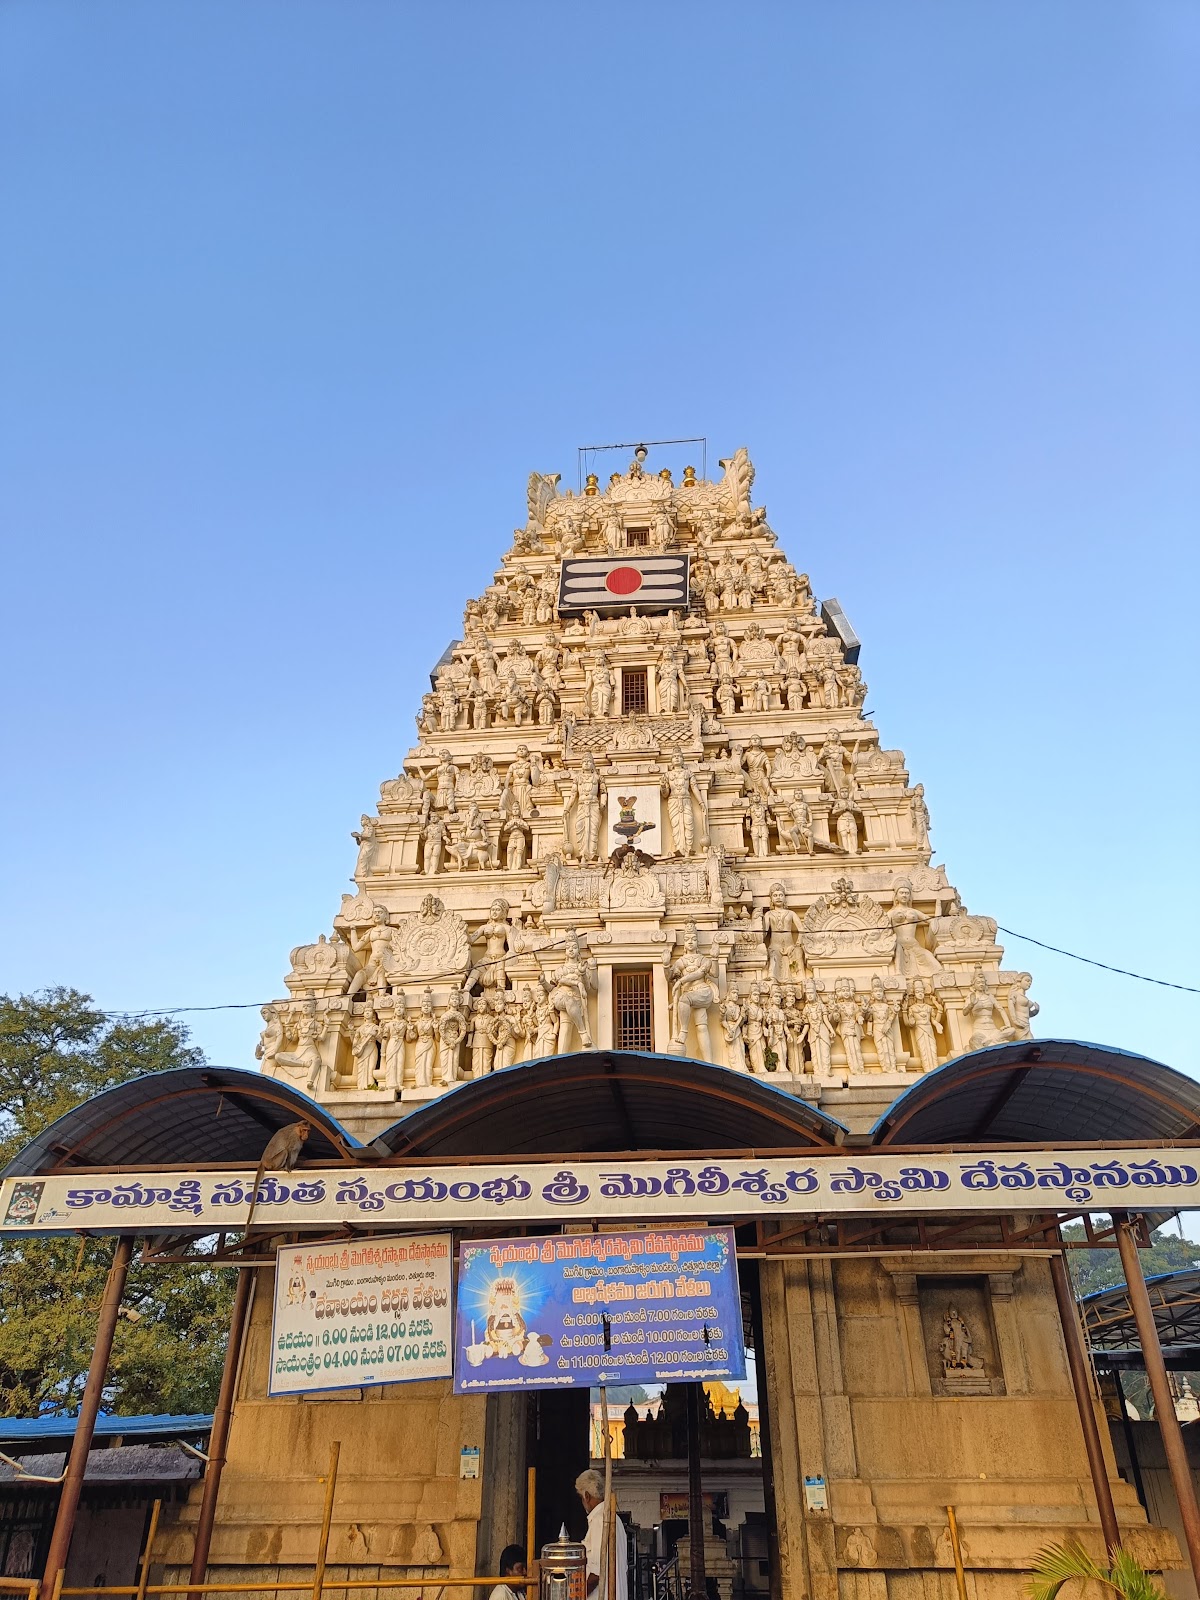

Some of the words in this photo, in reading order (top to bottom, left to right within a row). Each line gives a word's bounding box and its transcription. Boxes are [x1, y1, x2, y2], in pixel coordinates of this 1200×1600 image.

[66, 1180, 203, 1215] కామాక్షి
[210, 1177, 326, 1206] సమేత
[336, 1174, 532, 1211] స్వయంభు
[542, 1171, 590, 1204] శ్రీ
[597, 1166, 820, 1203] మొగిలీశ్వర
[829, 1164, 951, 1202] స్వామి
[306, 1252, 339, 1275] స్వయంభు
[340, 1250, 350, 1271] శ్రీ
[489, 1242, 539, 1267] స్వయంభు
[541, 1240, 555, 1263] శ్రీ
[314, 1291, 378, 1320] దేవాలయం
[380, 1286, 409, 1320] దర్శన
[412, 1282, 448, 1311] వేళలు
[572, 1279, 636, 1305] అభిషేకము
[636, 1279, 675, 1298] జరుగు
[675, 1275, 712, 1298] వేళలు
[576, 1313, 600, 1326] 6.00
[624, 1308, 648, 1324] నుండి
[648, 1310, 670, 1322] 7.00
[695, 1306, 718, 1320] వరకు
[277, 1331, 314, 1350] ఉదయం
[322, 1328, 348, 1346] 6.00
[350, 1324, 374, 1344] నుండి
[376, 1322, 406, 1341] 12.00
[408, 1318, 434, 1338] వరకు
[573, 1334, 596, 1346] 9.00
[620, 1328, 644, 1344] నుండి
[646, 1330, 675, 1343] 10.00
[275, 1353, 322, 1377] సాయంత్రం
[323, 1350, 358, 1369] 04.00
[360, 1345, 385, 1366] నుండి
[386, 1343, 420, 1363] 07.00
[422, 1340, 448, 1360] వరకు
[571, 1355, 600, 1368] 11.00
[625, 1349, 648, 1366] నుండి
[650, 1351, 680, 1364] 12.00
[704, 1348, 728, 1362] వరకు
